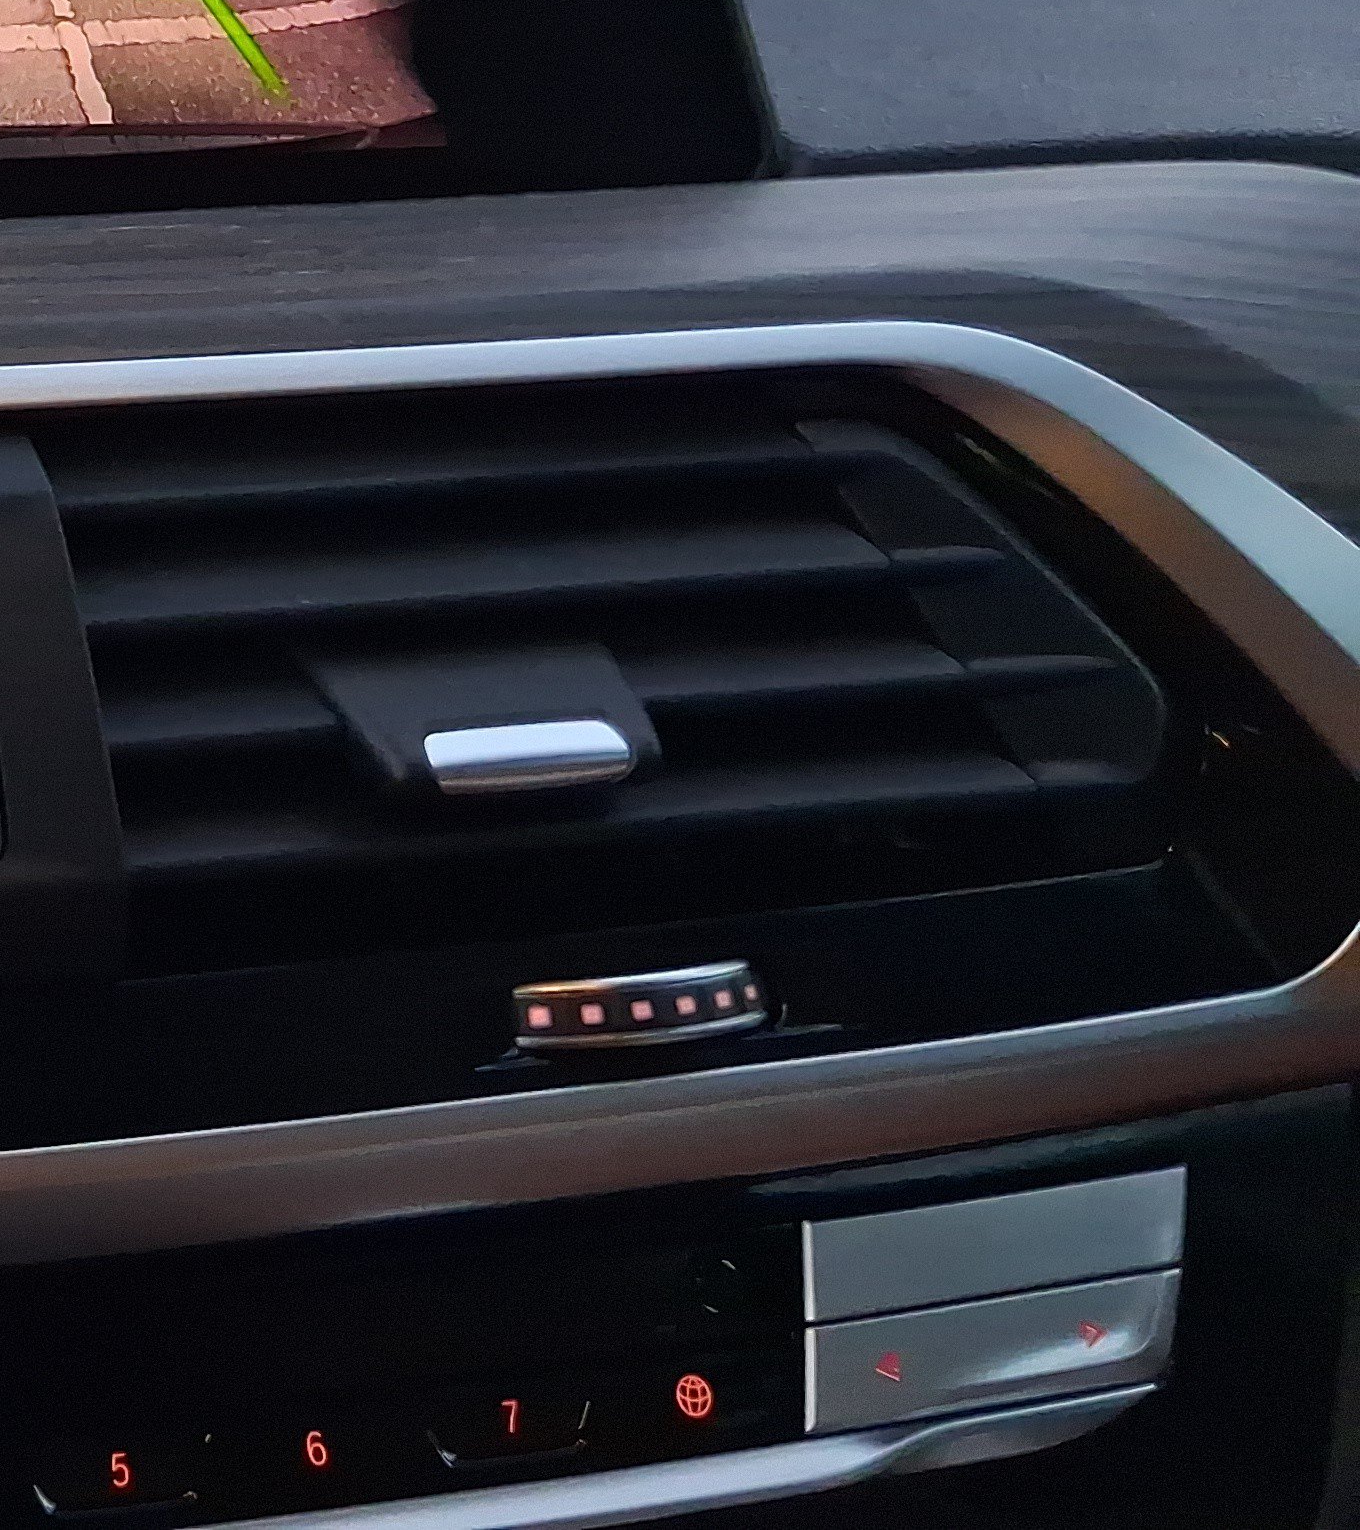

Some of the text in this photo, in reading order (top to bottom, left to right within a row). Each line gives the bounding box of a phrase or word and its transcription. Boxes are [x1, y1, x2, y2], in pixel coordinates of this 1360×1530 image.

[501, 1399, 519, 1434] 7
[307, 1430, 327, 1467] 6
[110, 1451, 131, 1488] 5
